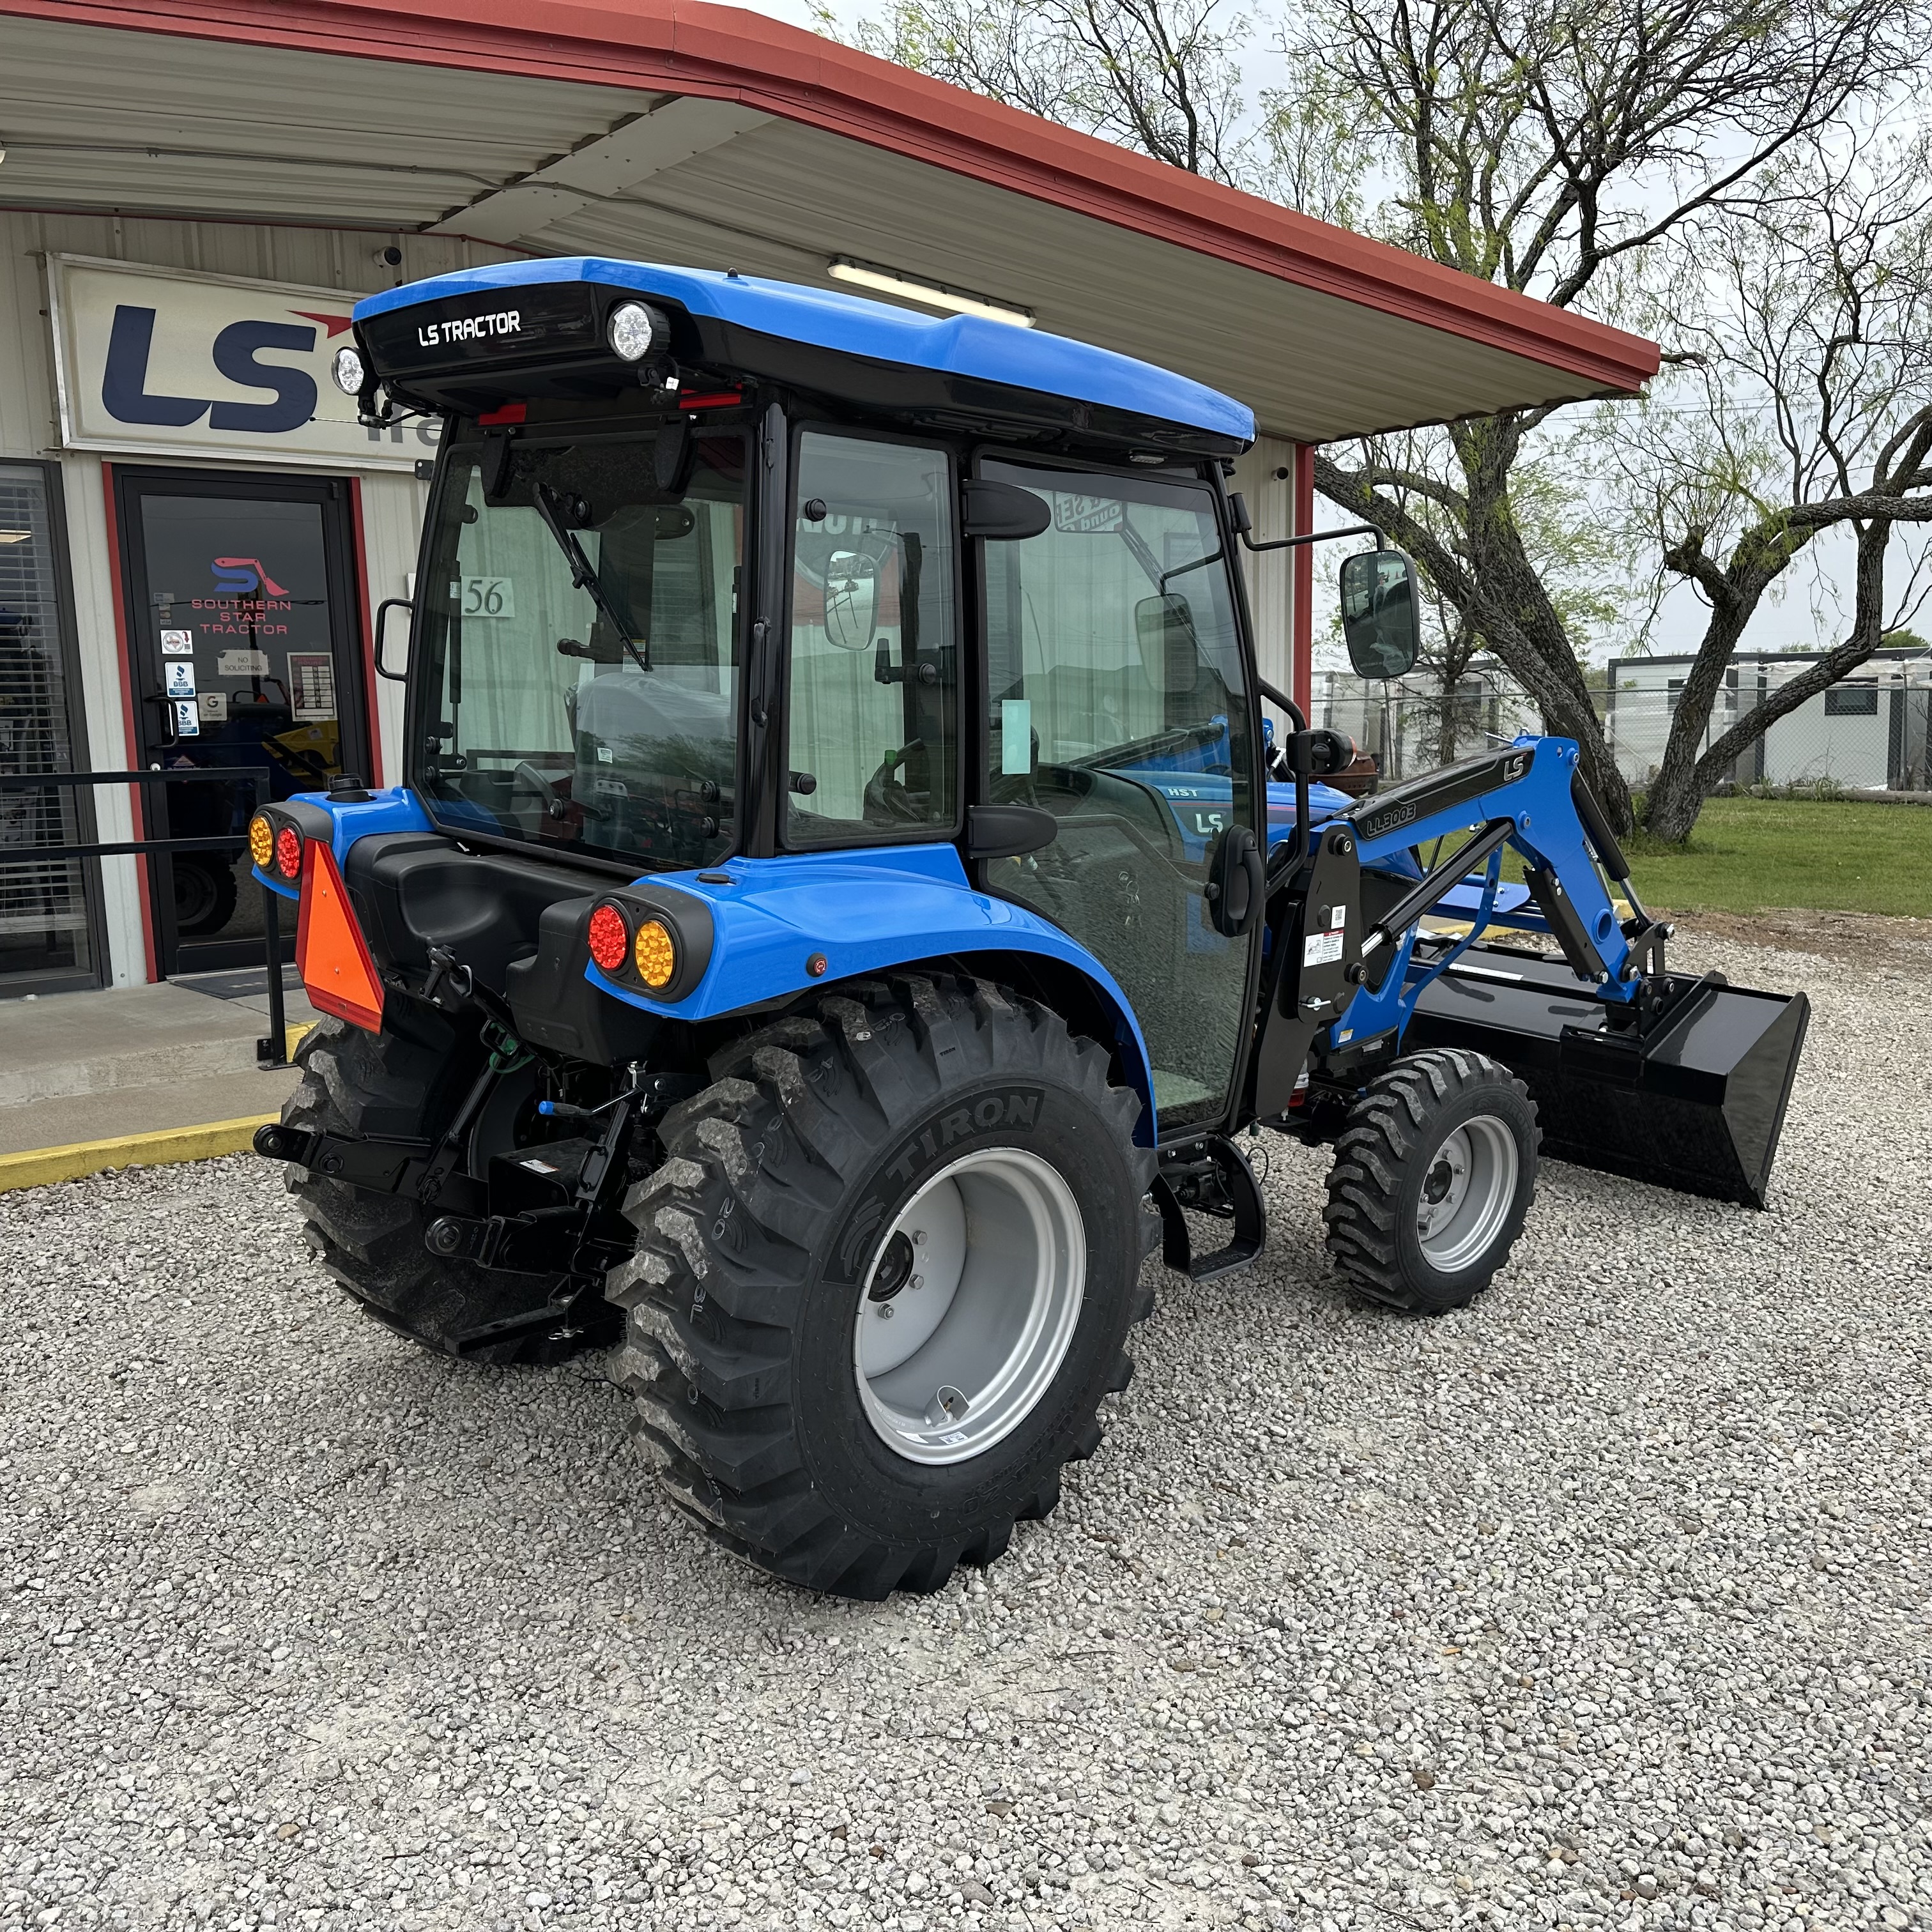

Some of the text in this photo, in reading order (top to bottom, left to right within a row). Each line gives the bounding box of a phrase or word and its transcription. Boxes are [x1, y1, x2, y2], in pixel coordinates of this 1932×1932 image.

[418, 310, 521, 346] LS TRACTOR
[102, 304, 318, 433] LS
[192, 599, 291, 610] SOUTHERN
[464, 579, 503, 615] 56
[200, 624, 288, 634] TRACTOR
[220, 612, 266, 622] STAR
[1503, 755, 1524, 781] LS
[1167, 788, 1199, 797] HST
[1195, 813, 1223, 833] LS
[1366, 802, 1416, 837] LL3003
[884, 1094, 1039, 1183] TIRON
